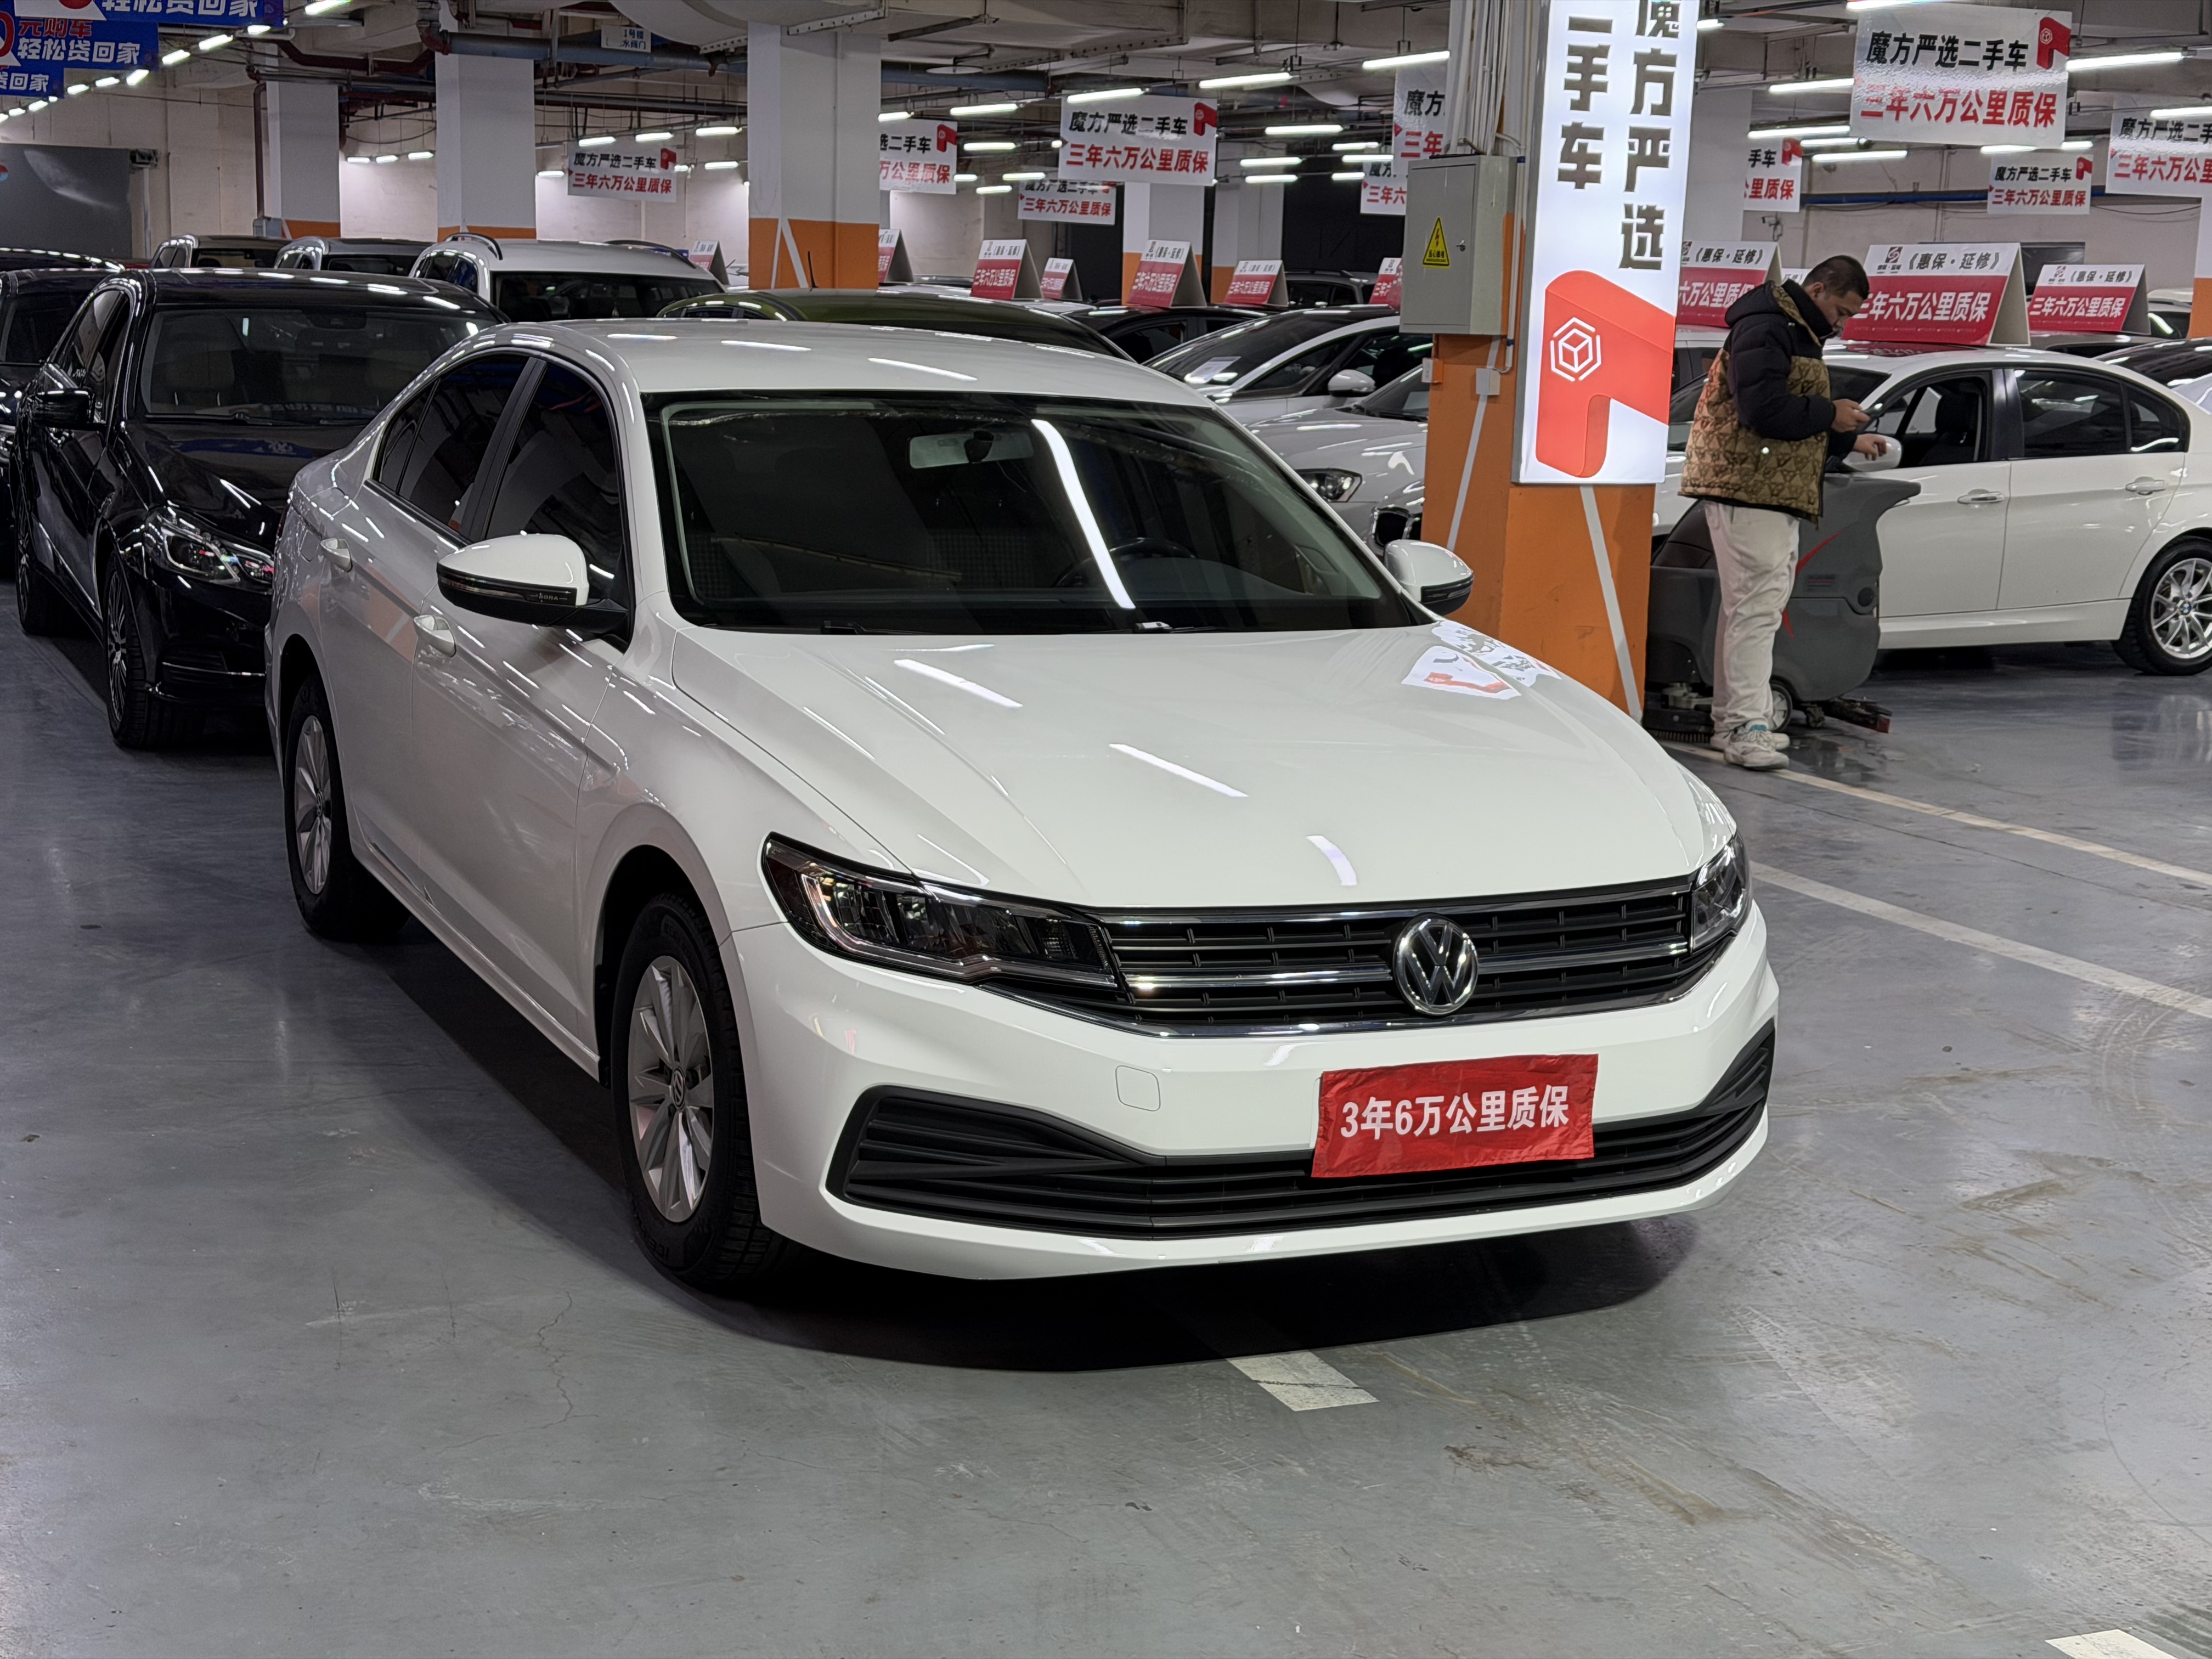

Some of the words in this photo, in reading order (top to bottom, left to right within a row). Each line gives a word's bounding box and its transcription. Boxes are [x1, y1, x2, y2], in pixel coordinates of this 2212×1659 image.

[17, 37, 140, 65] 轻松贷回家
[1866, 30, 2029, 72] 魔方严选二手车
[1404, 89, 1445, 116] 魔方
[1860, 84, 2057, 128] 三年六万公里质保
[1069, 111, 1188, 136] 魔方严选二手车
[1401, 131, 1444, 157] 三年
[573, 152, 657, 170] 魔方严选二手车
[1066, 143, 1209, 173] 三年六万公里质保
[1748, 149, 1777, 168] 手车
[2114, 154, 2212, 183] 三年六万公里
[572, 173, 672, 194] 三年六万公里质保
[879, 160, 950, 184] 万公里质保
[1994, 166, 2073, 183] 魔方严选二手车
[1023, 198, 1112, 217] 三年六万公里质保
[1367, 185, 1407, 205] 三年六
[1991, 189, 2086, 206] 三年六万公里质保
[1852, 291, 1991, 323] 三年六万公里质保
[2029, 296, 2127, 318] 三年六万公里质保
[1340, 1084, 1570, 1140] 3年6万公里质保
